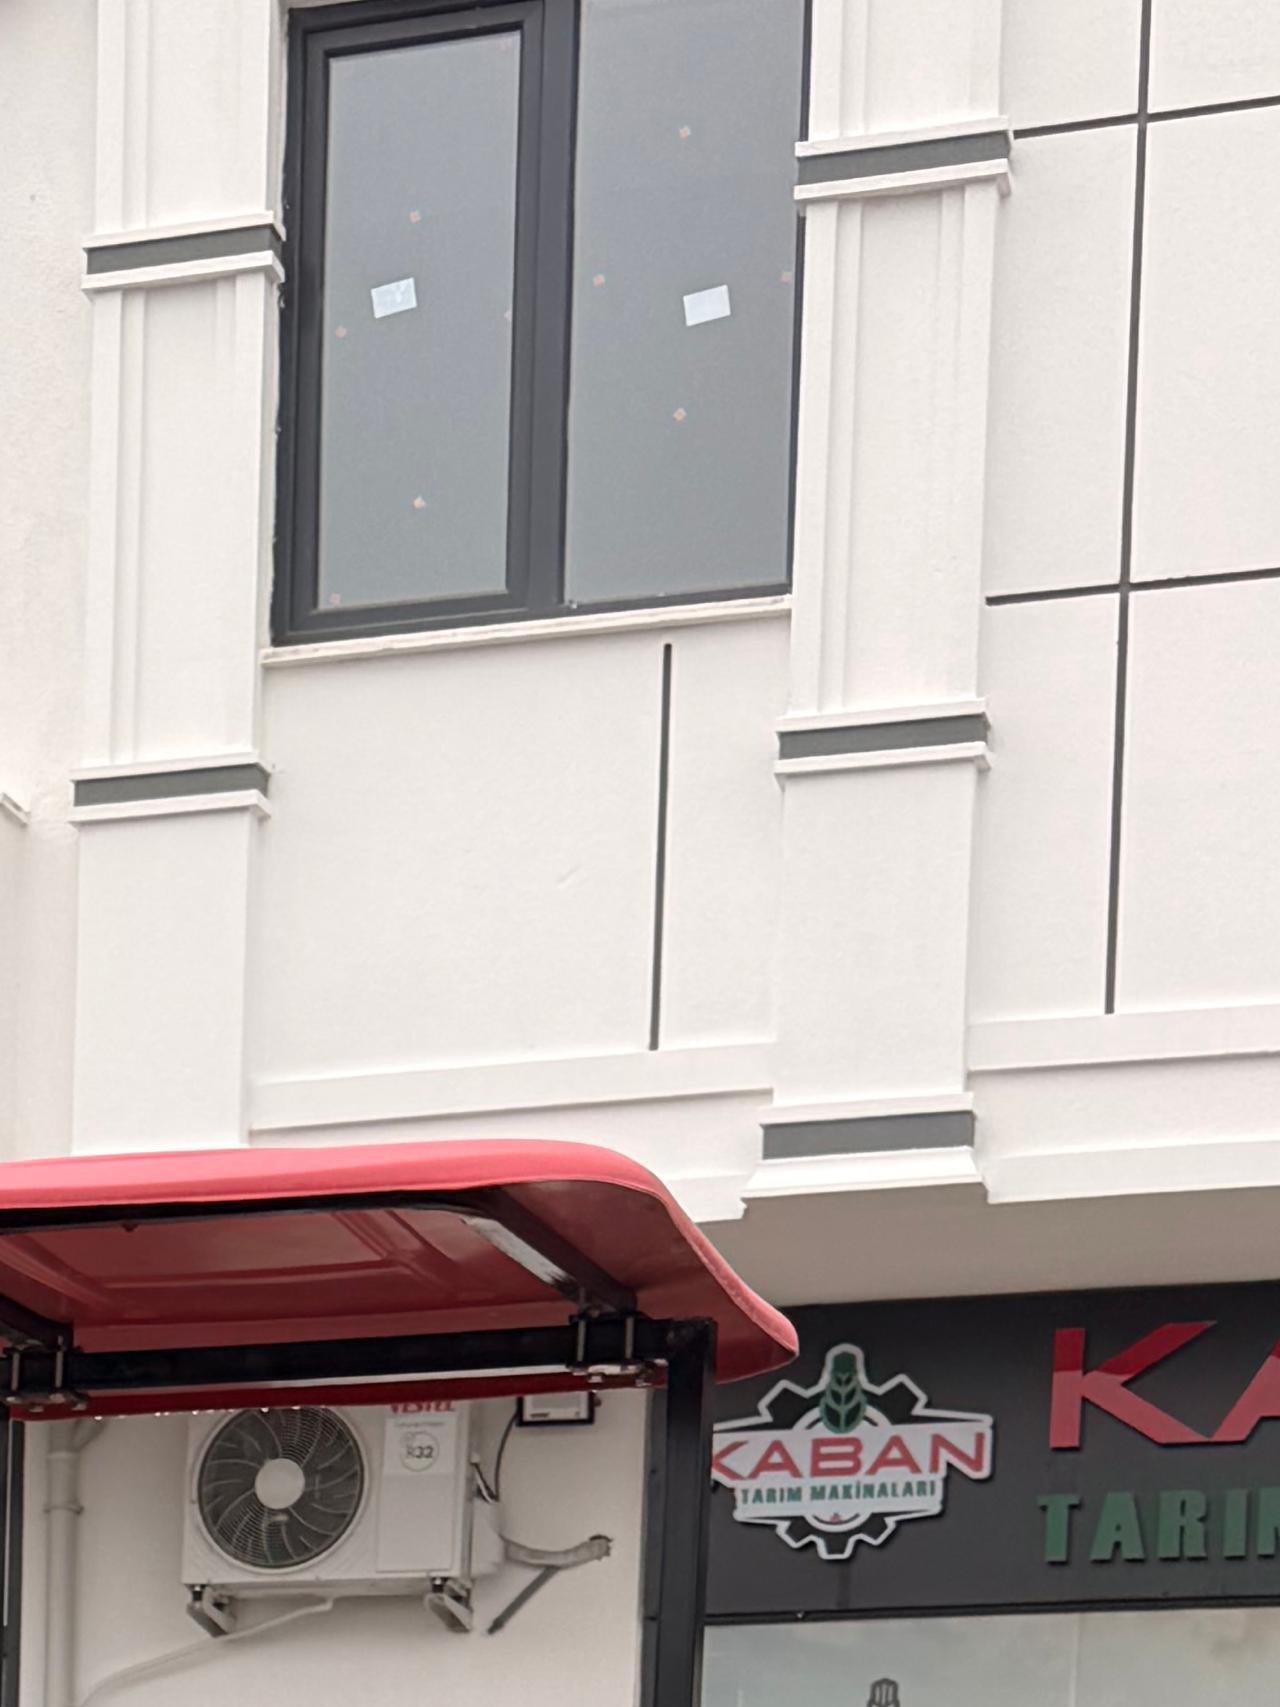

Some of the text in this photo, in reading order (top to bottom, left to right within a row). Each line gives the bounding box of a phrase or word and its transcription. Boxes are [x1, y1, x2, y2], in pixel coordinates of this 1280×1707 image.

[712, 1432, 986, 1481] KABAN
[740, 1480, 936, 1505] TARIM MAKİNALARI
